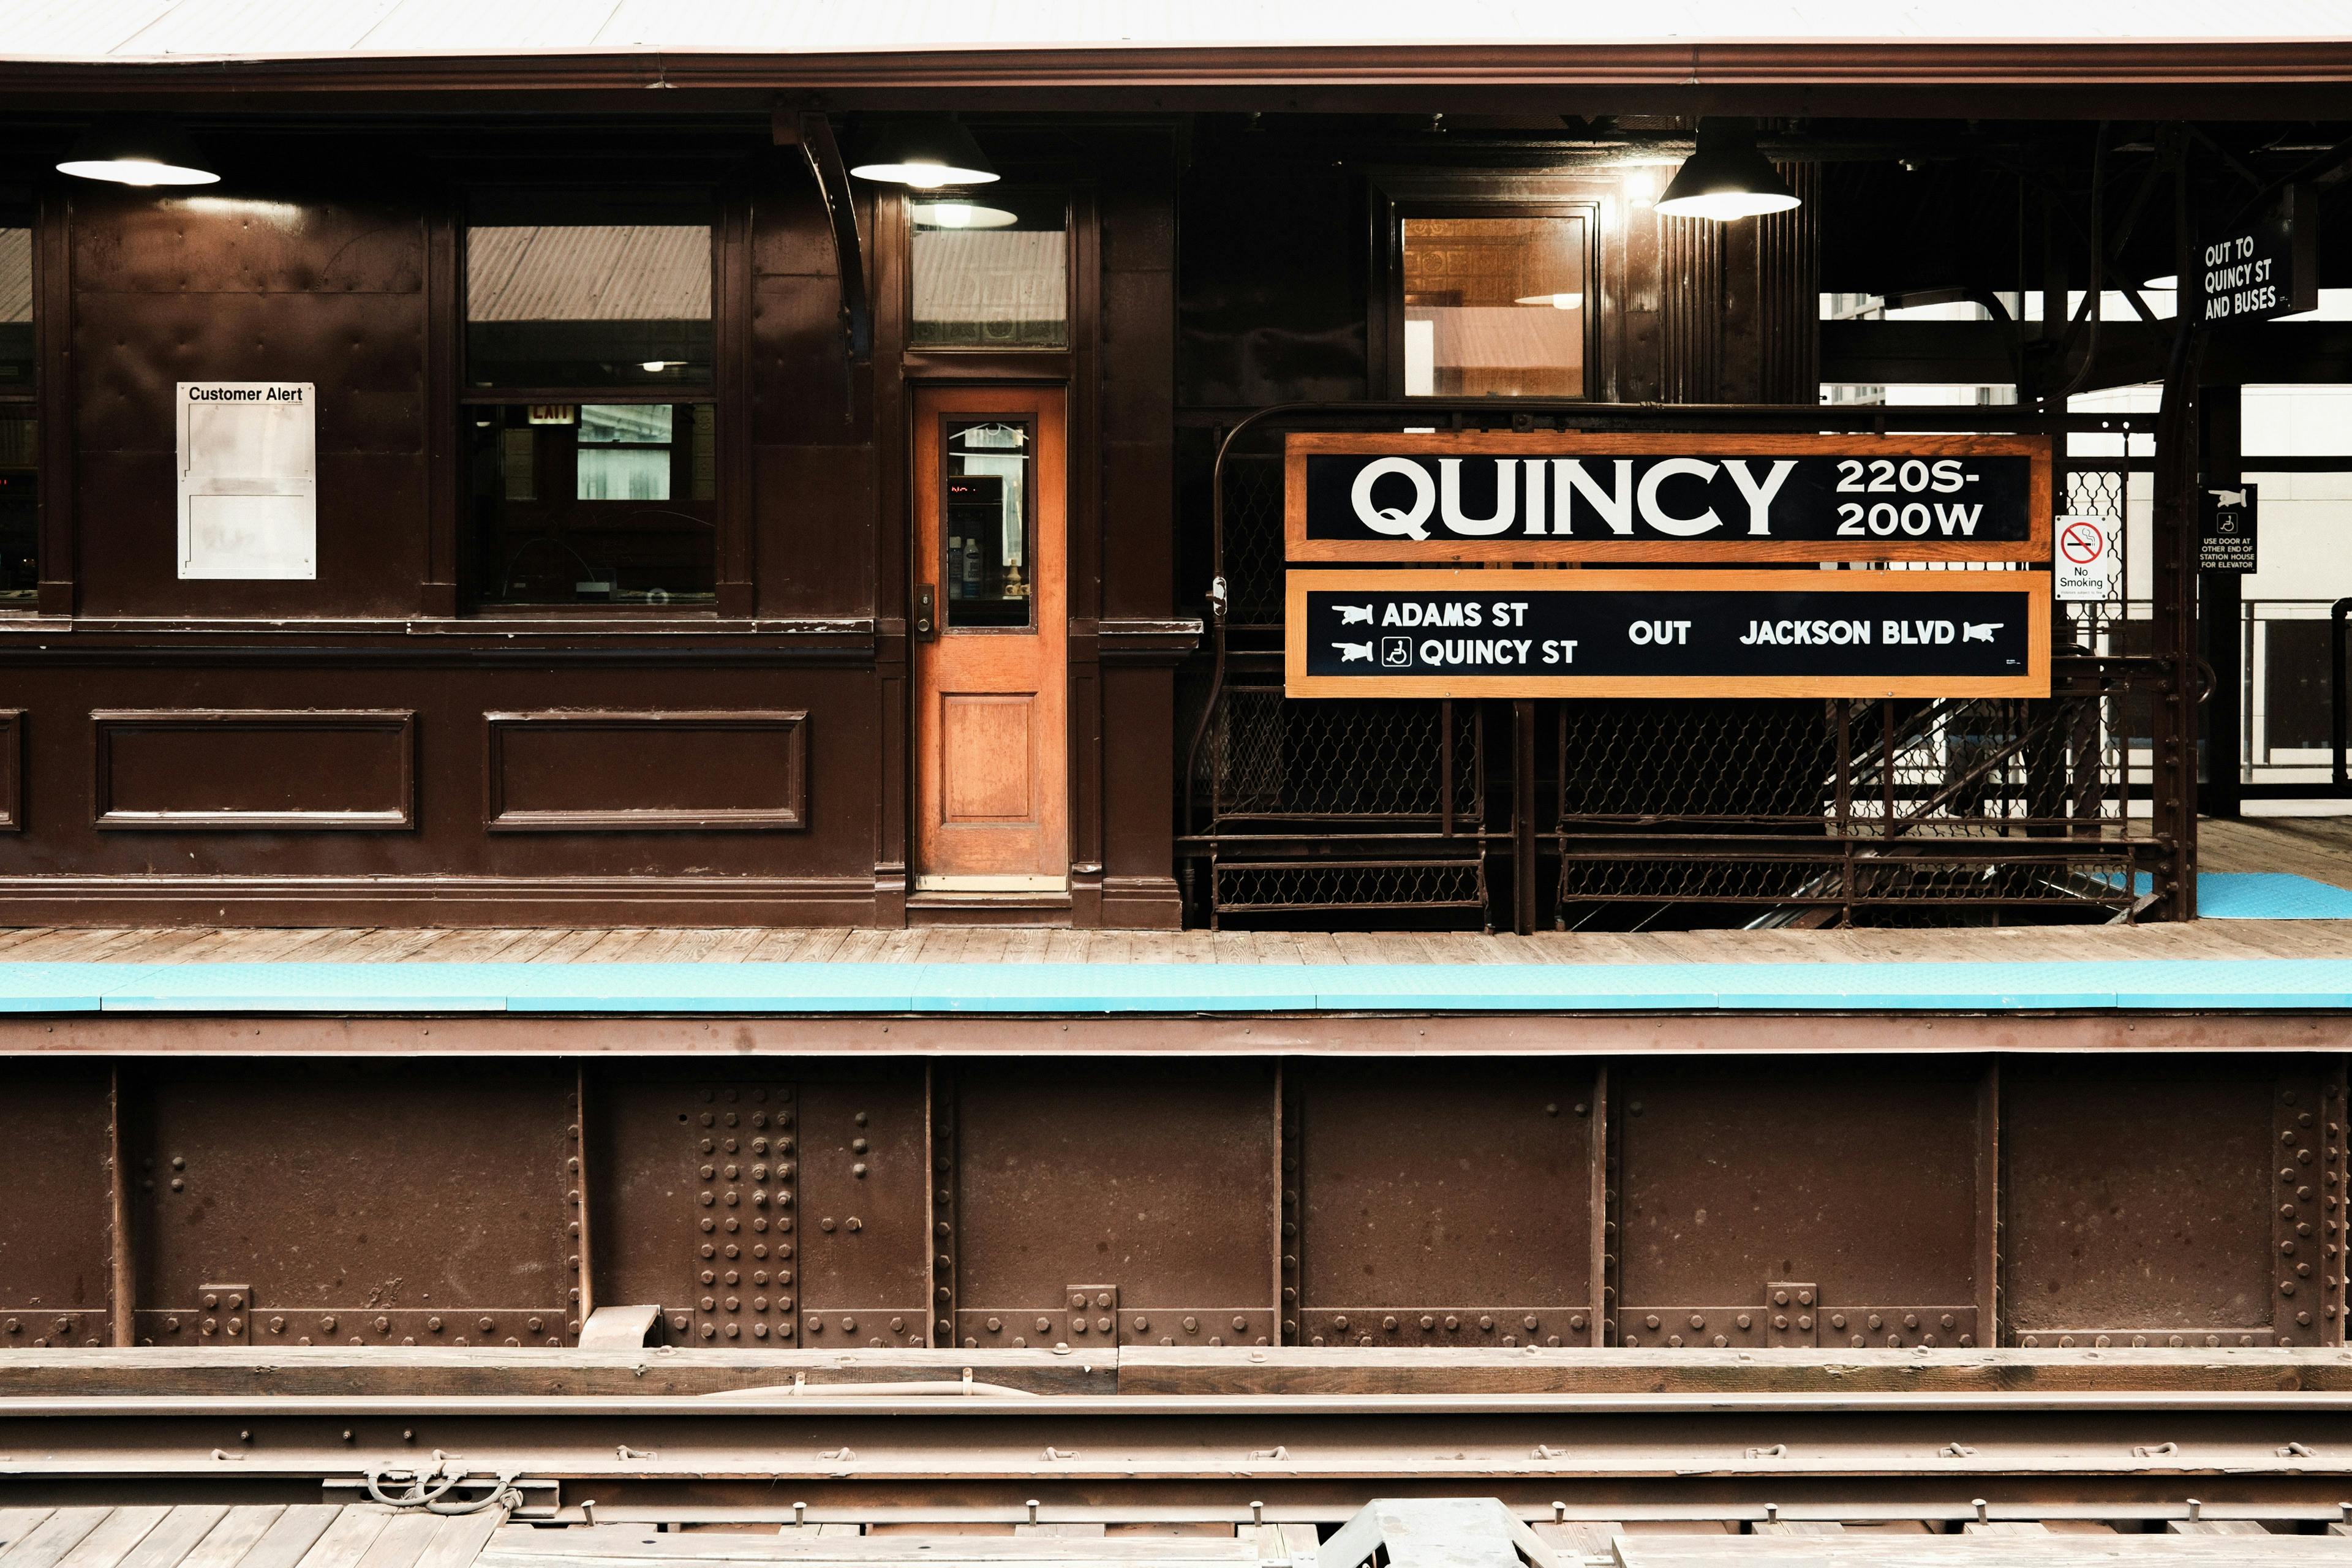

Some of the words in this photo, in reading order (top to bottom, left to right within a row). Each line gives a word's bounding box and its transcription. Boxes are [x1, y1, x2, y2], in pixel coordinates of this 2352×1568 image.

[2205, 241, 2231, 267] OUT
[2236, 235, 2254, 259] TO
[2205, 263, 2252, 294] QUINCY
[2255, 258, 2272, 282] ST
[2205, 296, 2230, 320] AND
[2234, 285, 2276, 314] BUSES
[189, 386, 262, 401] Customer
[266, 387, 303, 401] Alert
[1836, 459, 1980, 493] 220S-
[1351, 456, 1800, 541] QUINCY
[1836, 502, 1984, 536] 200W
[2060, 577, 2103, 589] Smoking
[2075, 567, 2088, 576] No
[1381, 602, 1482, 627] ADAMS
[1491, 602, 1529, 627] ST
[1628, 620, 1691, 645] OUT
[1739, 620, 1871, 645] JACKSON
[1882, 620, 1955, 645] BLVD
[1419, 639, 1532, 666] QUINCY
[1542, 639, 1578, 664] ST
